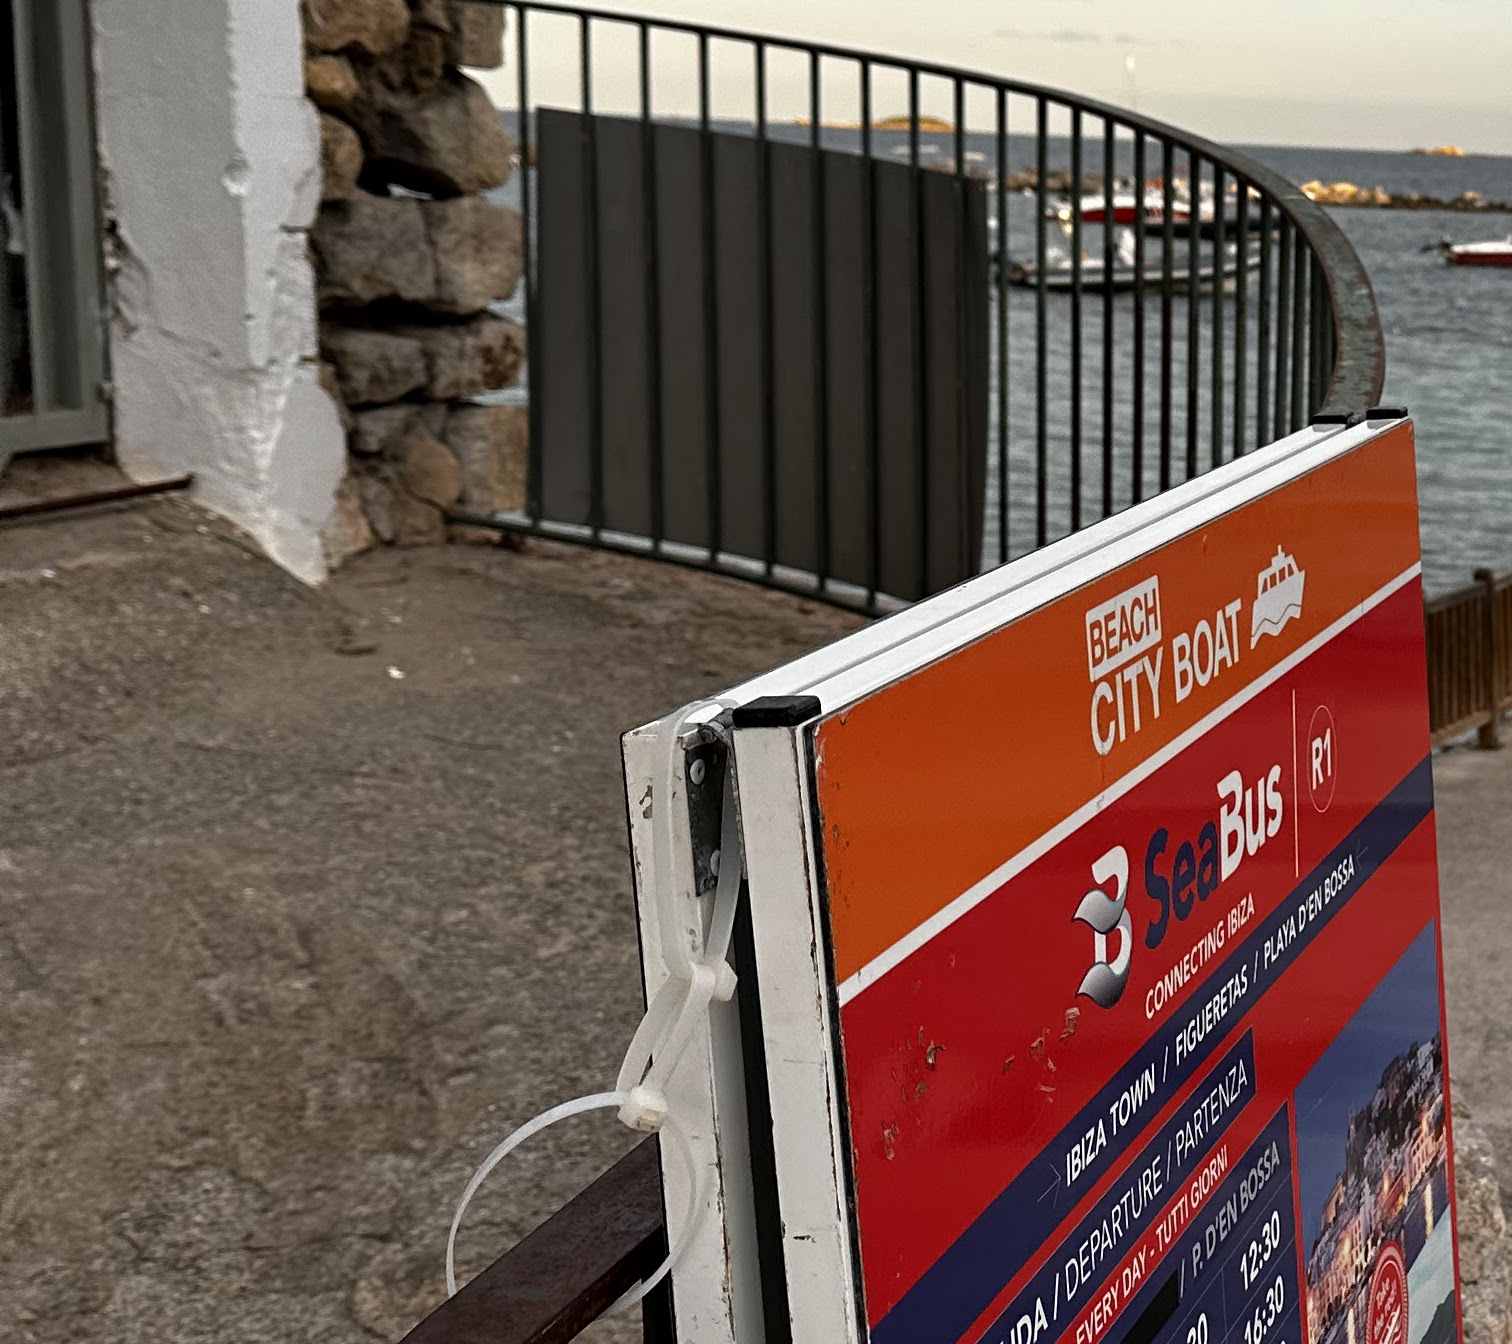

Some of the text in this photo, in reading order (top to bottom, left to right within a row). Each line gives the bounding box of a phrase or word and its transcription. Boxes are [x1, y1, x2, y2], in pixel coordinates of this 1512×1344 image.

[1089, 587, 1160, 669] BEACH
[1091, 598, 1242, 756] CITY BOAT
[1312, 728, 1332, 790] R1
[1144, 764, 1283, 950] SeaBus
[1066, 853, 1356, 1188] IBIZA TOWN / FIGUERETAS / PLAYA D'EN BOSSA
[1145, 892, 1256, 1020] CONNECTING IBIZA
[1052, 1272, 1060, 1321] /
[1065, 1154, 1163, 1302] DEPARTURE
[1166, 1140, 1172, 1183] /
[1175, 1058, 1248, 1168] PARTENZA
[1121, 1244, 1148, 1298] DAY
[1155, 1192, 1189, 1253] TUTTI
[1190, 1143, 1229, 1210] GIORNI
[1192, 1241, 1204, 1279] P.
[1205, 1192, 1238, 1261] D'EN
[1239, 1140, 1281, 1214] BOSSA
[1239, 1210, 1281, 1291] 12:30
